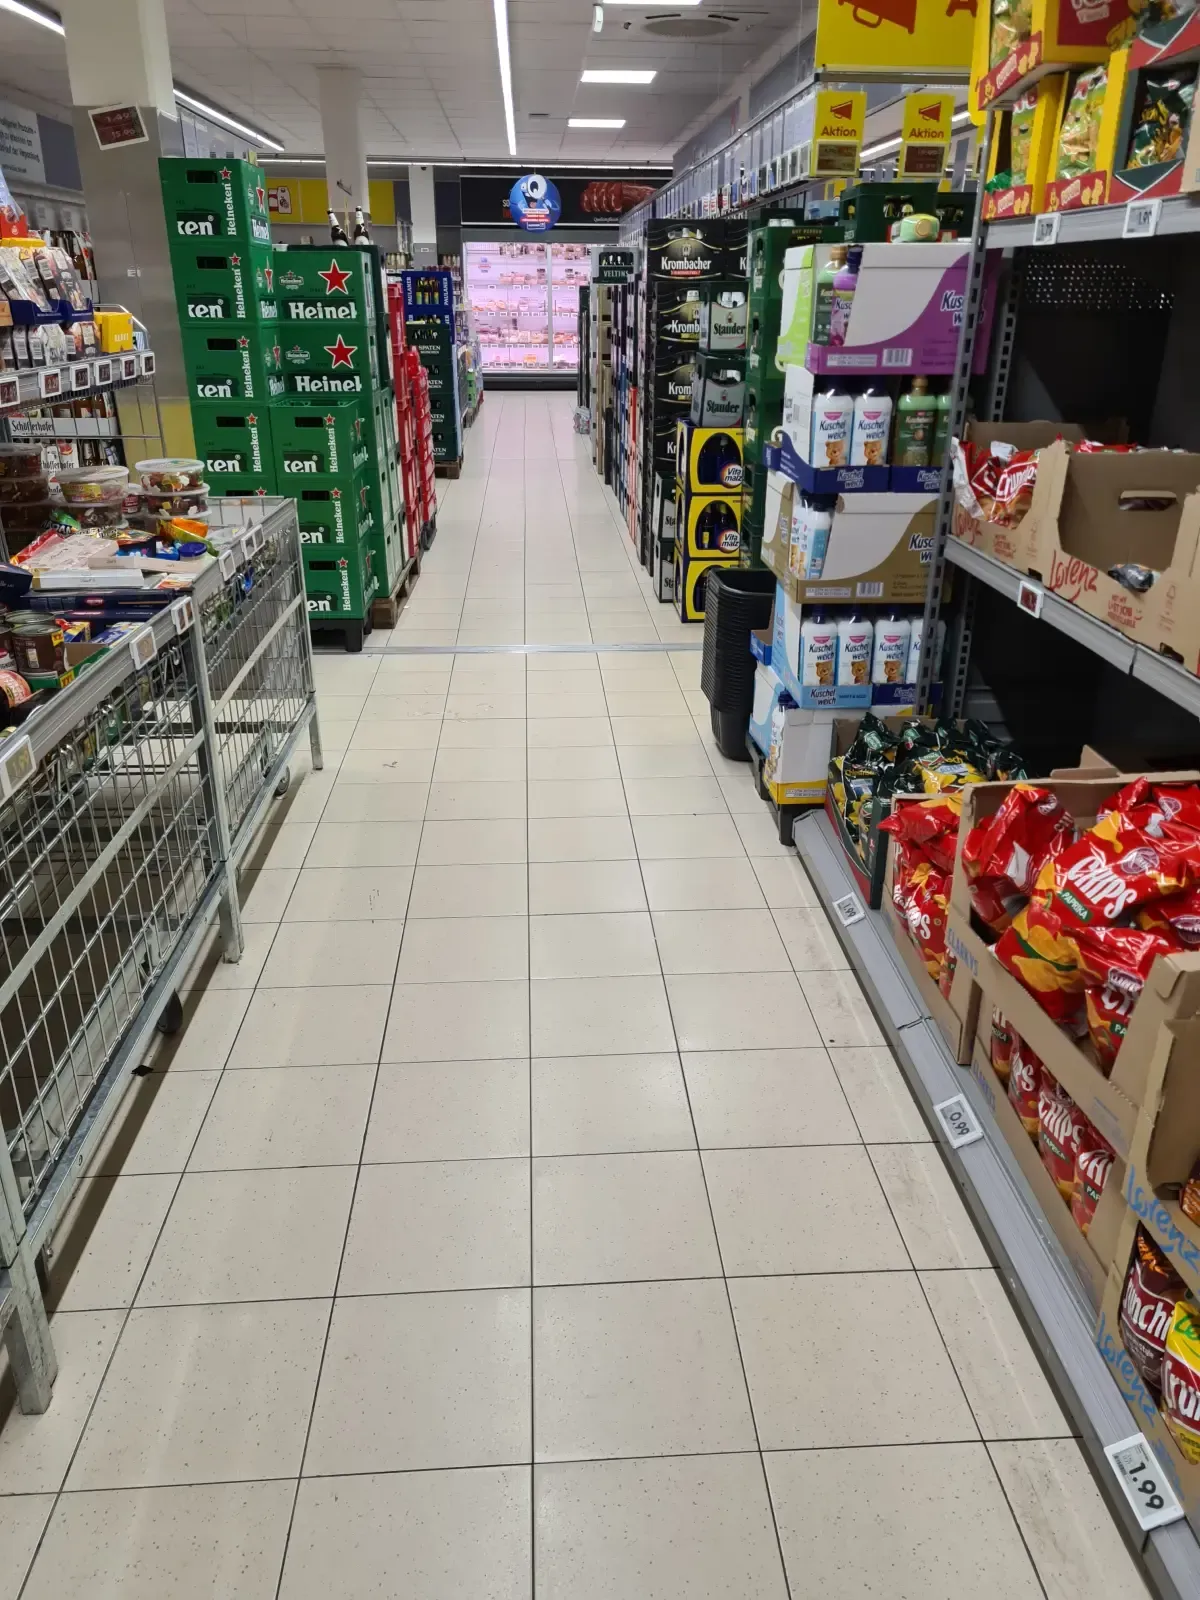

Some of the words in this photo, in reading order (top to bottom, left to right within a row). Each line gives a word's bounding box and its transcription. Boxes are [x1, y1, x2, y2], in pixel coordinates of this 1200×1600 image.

[821, 126, 857, 137] Aktion
[909, 128, 944, 139] Aktion
[225, 183, 236, 236] Heineken
[661, 256, 712, 270] Krombacher
[235, 267, 246, 319] Heineken
[242, 350, 254, 399] Heineken
[819, 420, 846, 431] Kuschel
[858, 420, 884, 431] Kuschel
[827, 431, 846, 440] weich
[866, 431, 885, 440] weich
[251, 427, 262, 473] Heineken
[328, 427, 339, 473] Heineken
[726, 467, 741, 476] Vita
[724, 474, 742, 482] malz
[334, 500, 345, 544] Heineken
[721, 539, 740, 547] malz
[723, 534, 739, 542] Vita
[1049, 549, 1099, 593] Lorenz
[341, 569, 352, 612] Heineken
[808, 643, 833, 654] Kuschel
[844, 643, 869, 653] Kuschel
[878, 642, 903, 652] Kuschel
[816, 652, 834, 661] weich
[852, 651, 869, 661] weich
[886, 651, 904, 660] weich
[810, 689, 836, 699] Kuschel
[817, 697, 836, 706] weich
[1068, 855, 1138, 919] CHIPS
[843, 902, 857, 918] 1.99
[1061, 891, 1089, 920] PAPRIKA
[1114, 1023, 1127, 1035] PA
[950, 1111, 970, 1136] 0.99
[1038, 1091, 1085, 1153] CHIPS
[1129, 1462, 1164, 1510] 1.99
